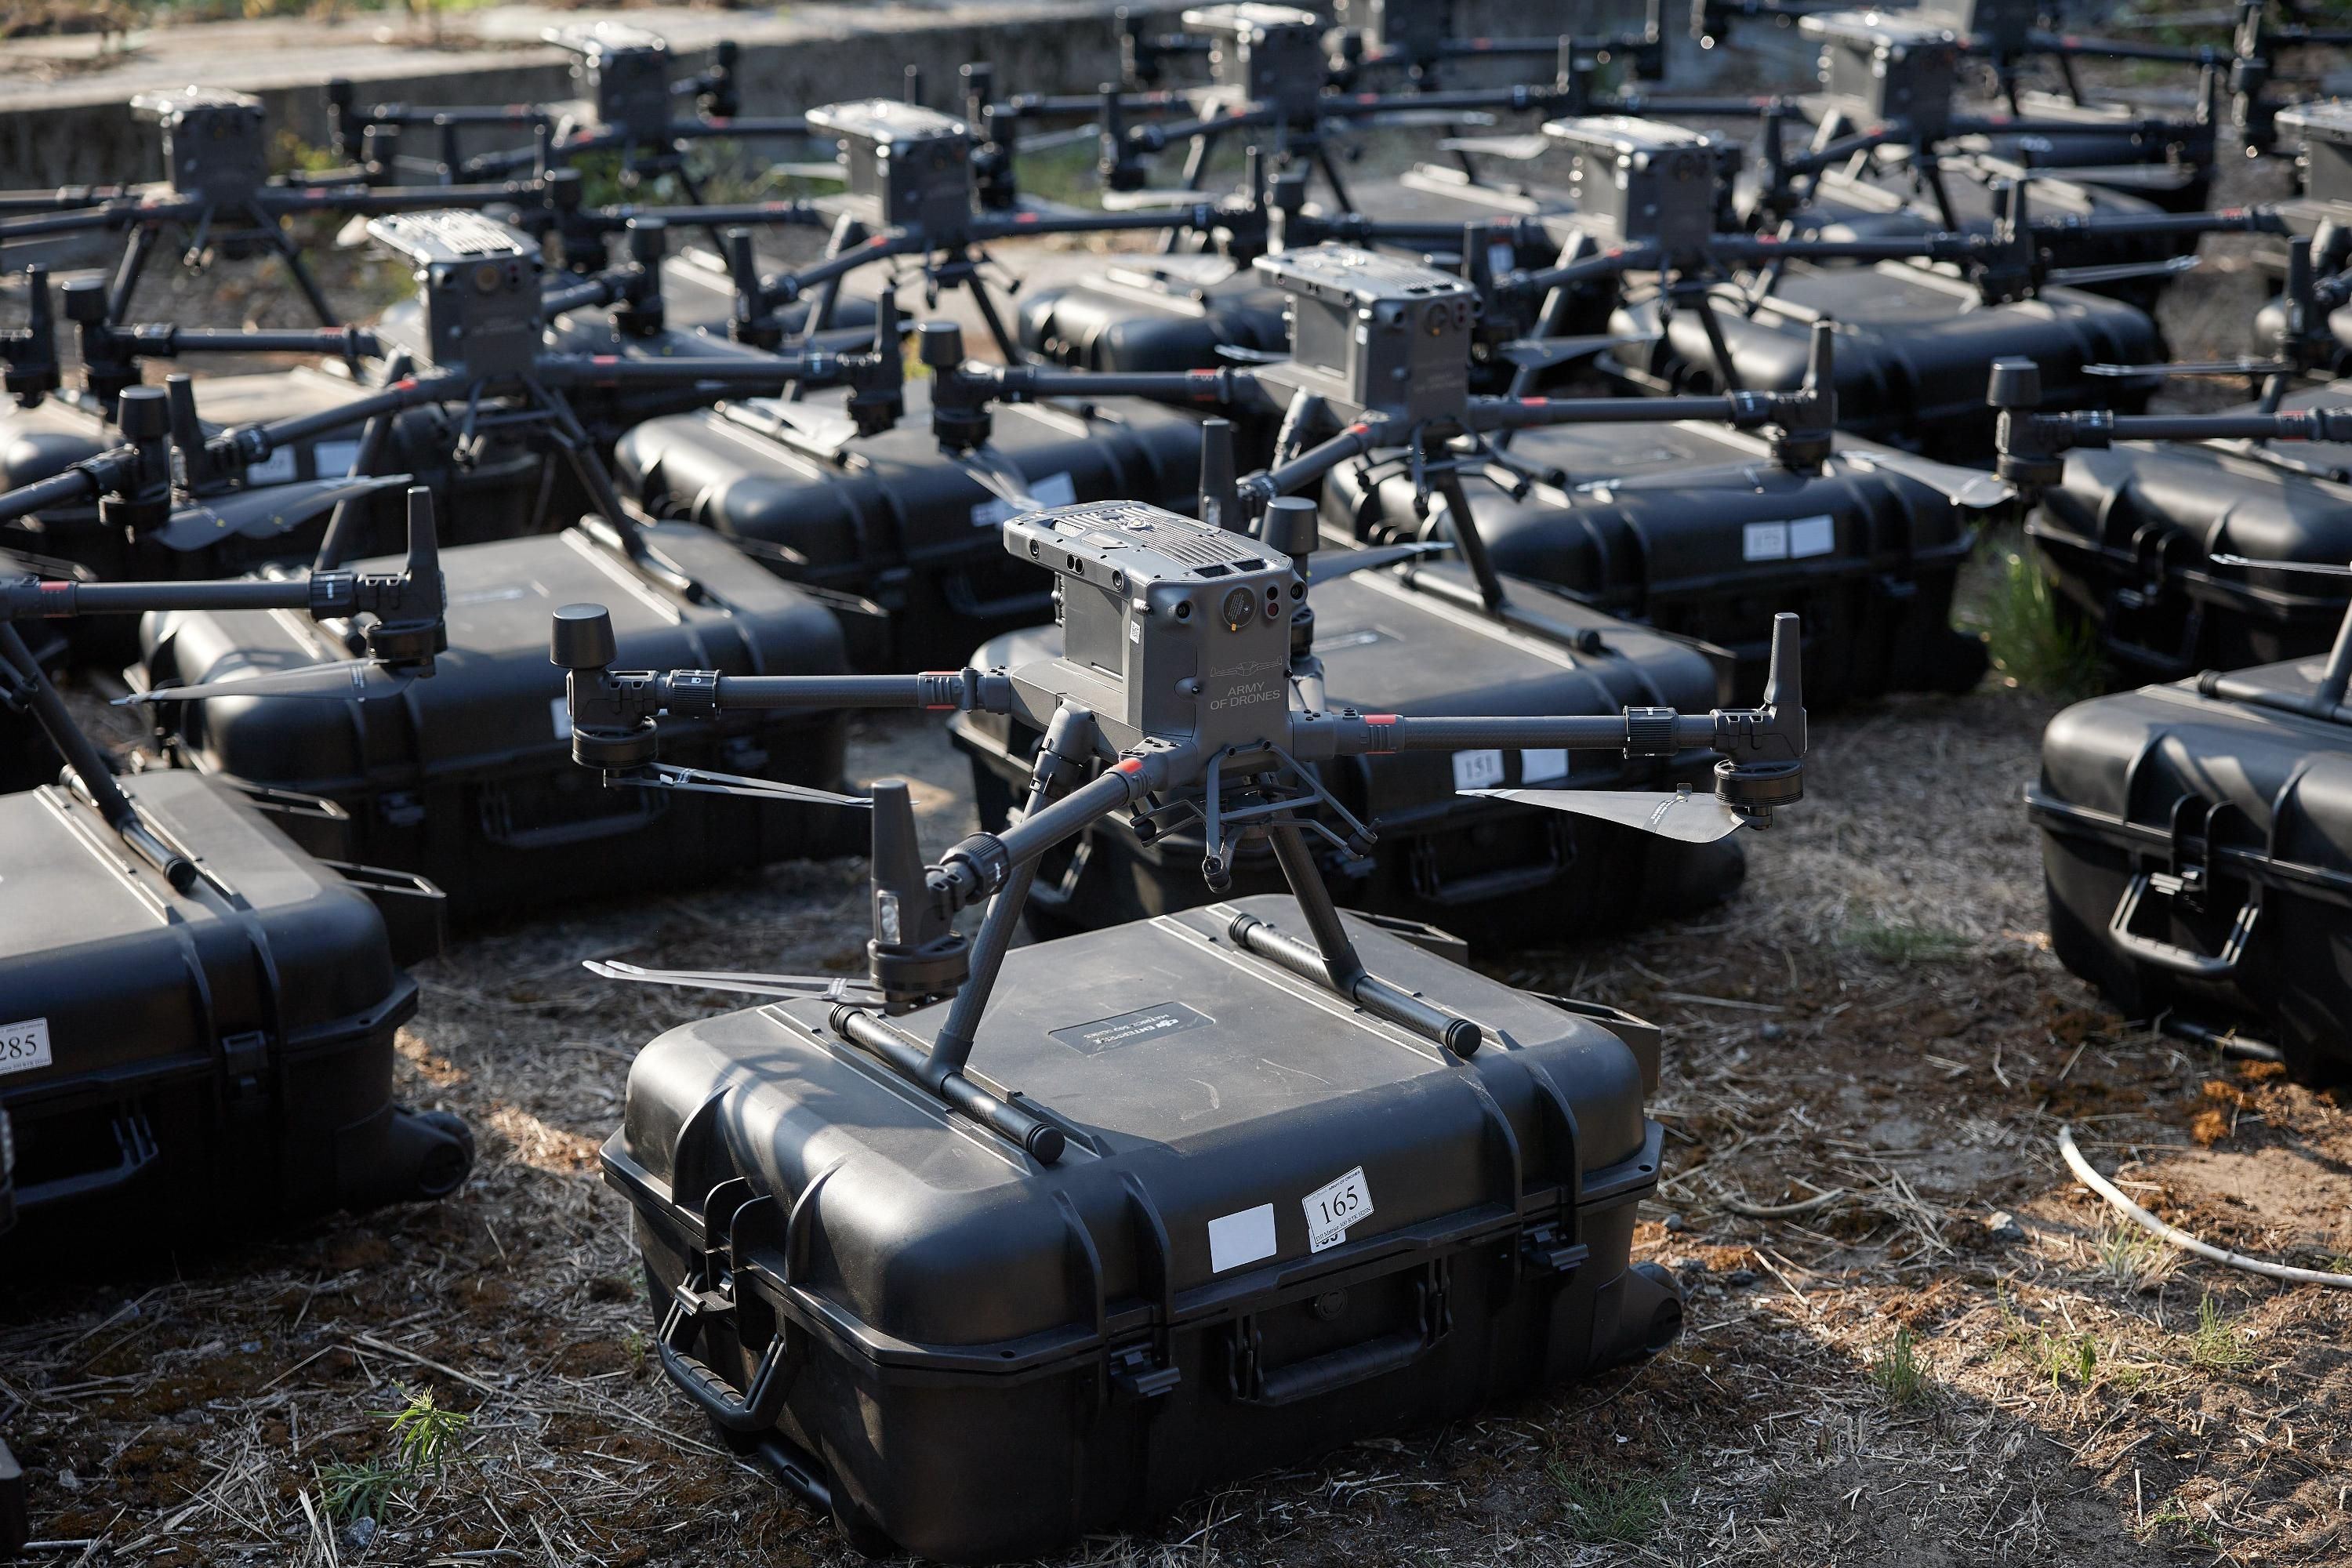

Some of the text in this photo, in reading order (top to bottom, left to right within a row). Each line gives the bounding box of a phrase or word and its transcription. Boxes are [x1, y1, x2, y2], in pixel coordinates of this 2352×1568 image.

[1228, 681, 1265, 697] ARMY
[1210, 690, 1280, 710] OF DRONES
[1328, 1181, 1340, 1191] ARMY
[1319, 1185, 1358, 1225] 165
[1323, 1225, 1339, 1237] Matrice
[1348, 1214, 1358, 1223] RTK
